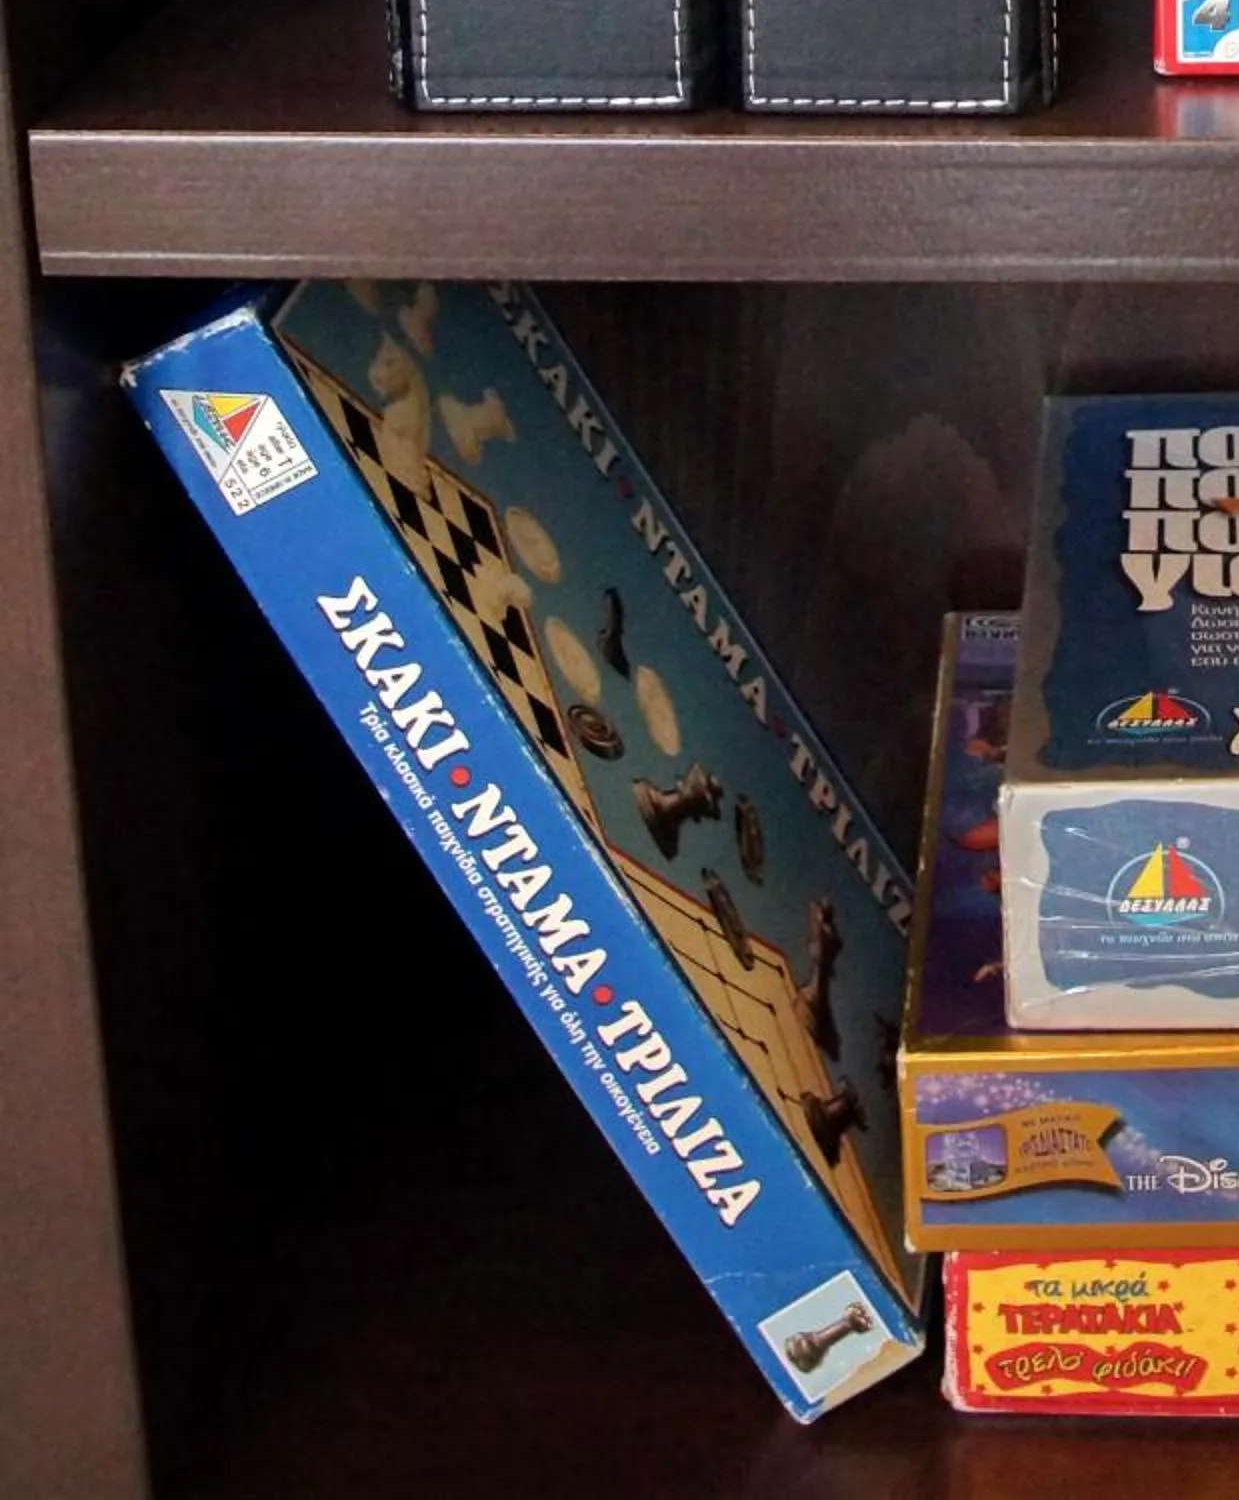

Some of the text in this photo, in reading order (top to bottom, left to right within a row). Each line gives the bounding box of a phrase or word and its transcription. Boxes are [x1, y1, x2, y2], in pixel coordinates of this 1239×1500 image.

[317, 576, 761, 1226] ΣΚΑΚΙ ΝΤΑΜΑ ΤΡΙΛΙΖΑ
[359, 702, 660, 1155] Τρία κλασικά παιχνίδια στρατηγικής για όλη την οικογένεια
[789, 734, 912, 935] ΤΡΙΛΙΖ
[1126, 1174, 1159, 1191] THE
